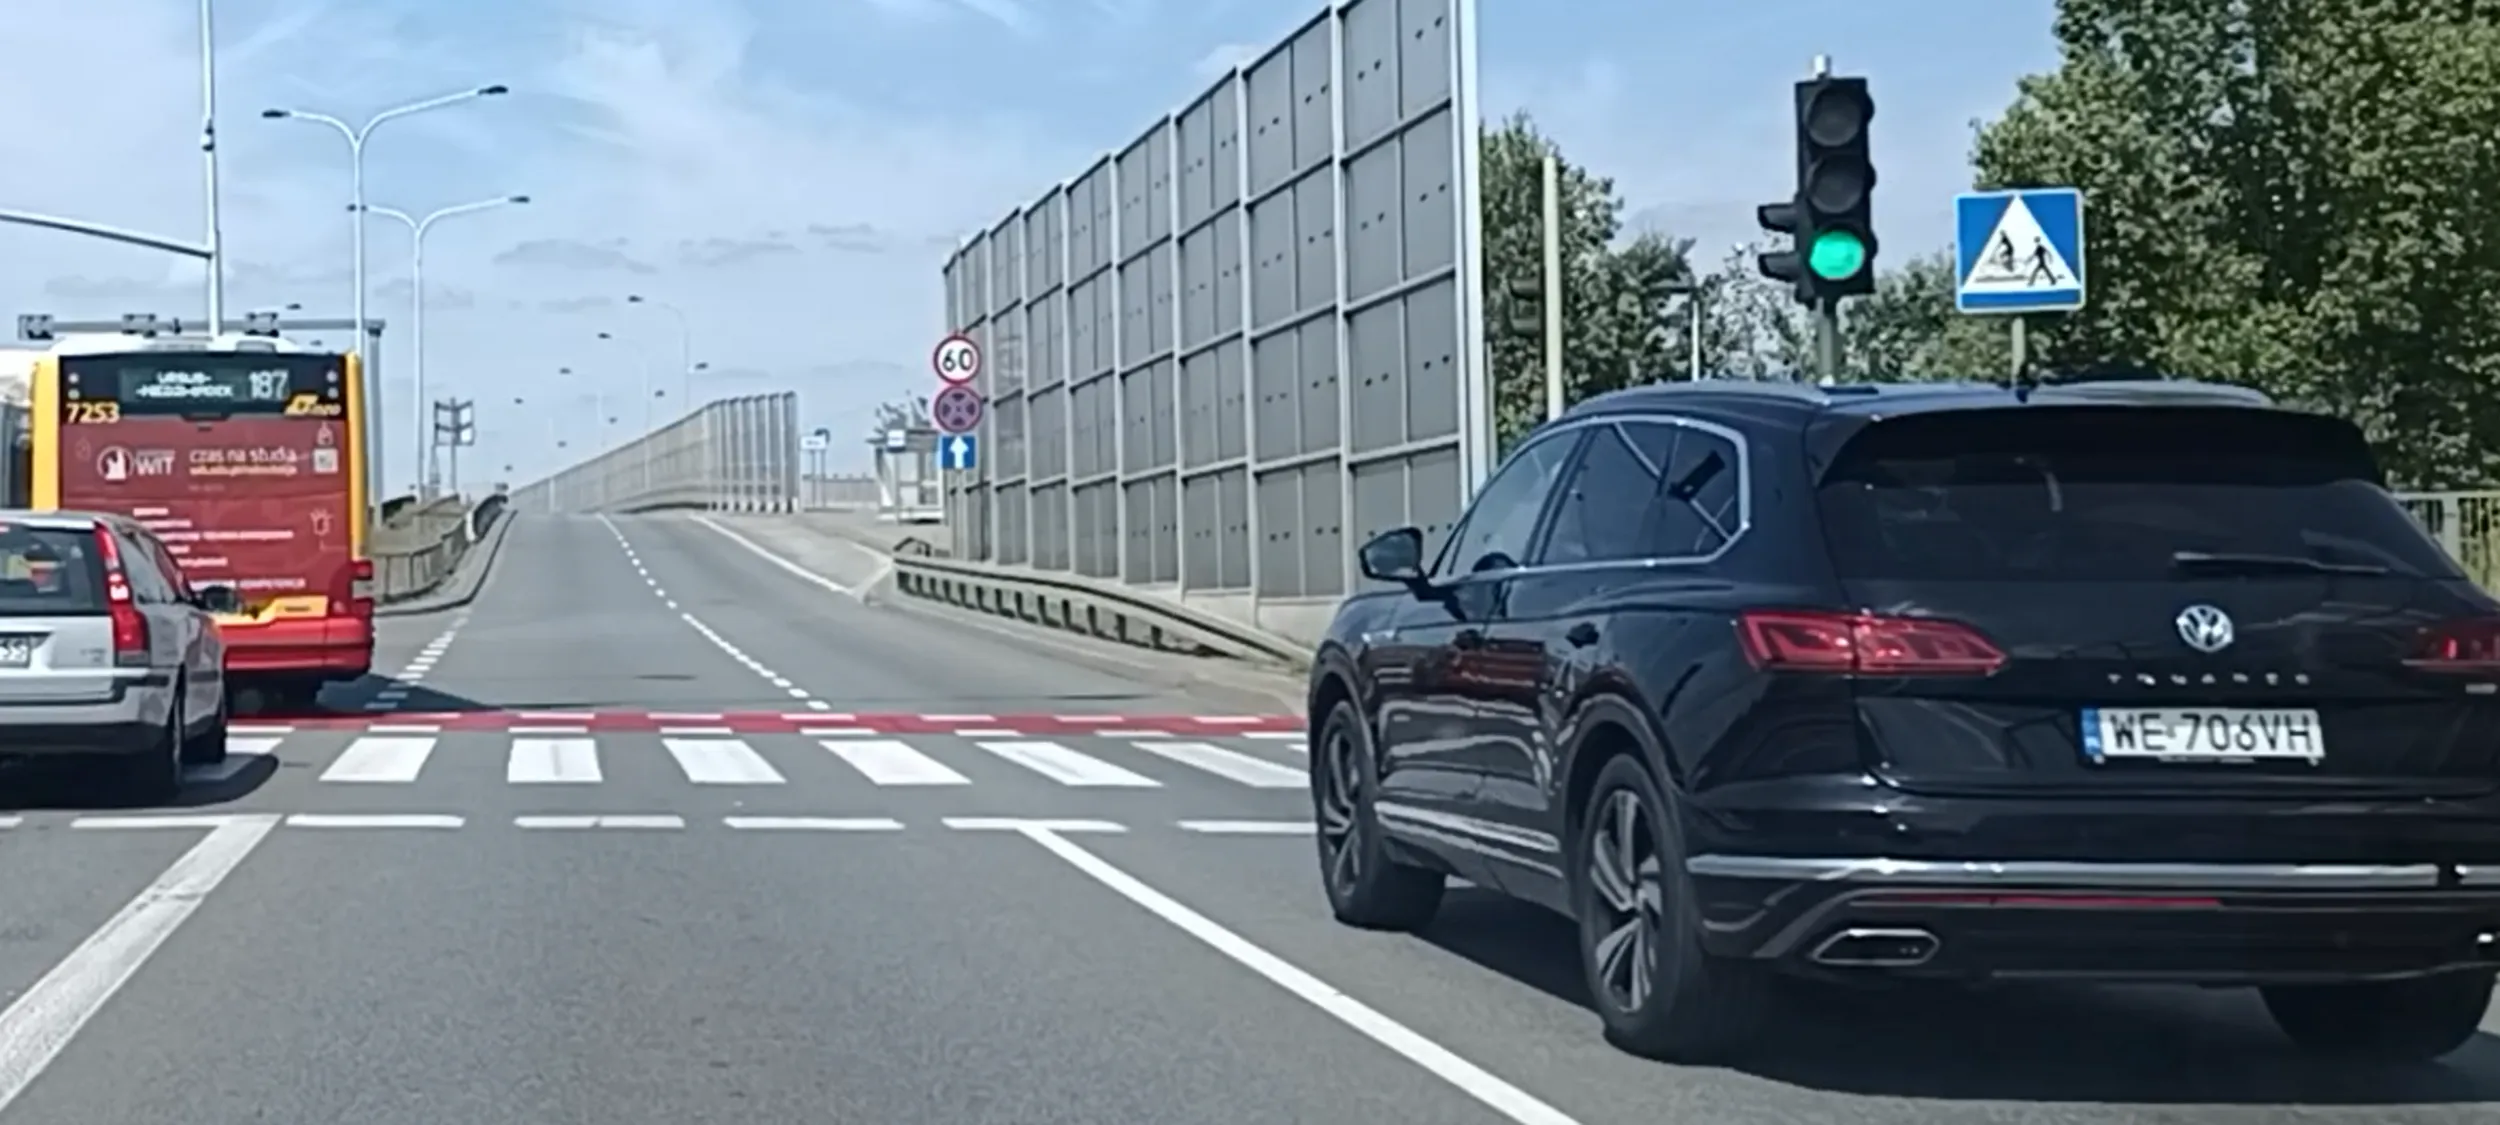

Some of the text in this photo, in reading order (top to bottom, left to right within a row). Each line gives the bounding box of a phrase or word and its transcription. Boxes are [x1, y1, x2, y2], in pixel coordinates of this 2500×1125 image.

[942, 348, 973, 372] 60
[248, 369, 289, 399] 187
[66, 402, 120, 424] 7253
[136, 456, 175, 476] WIT
[189, 449, 224, 463] czas
[227, 449, 246, 463] na
[2109, 713, 2168, 751] WE
[2180, 713, 2314, 752] 706VH
